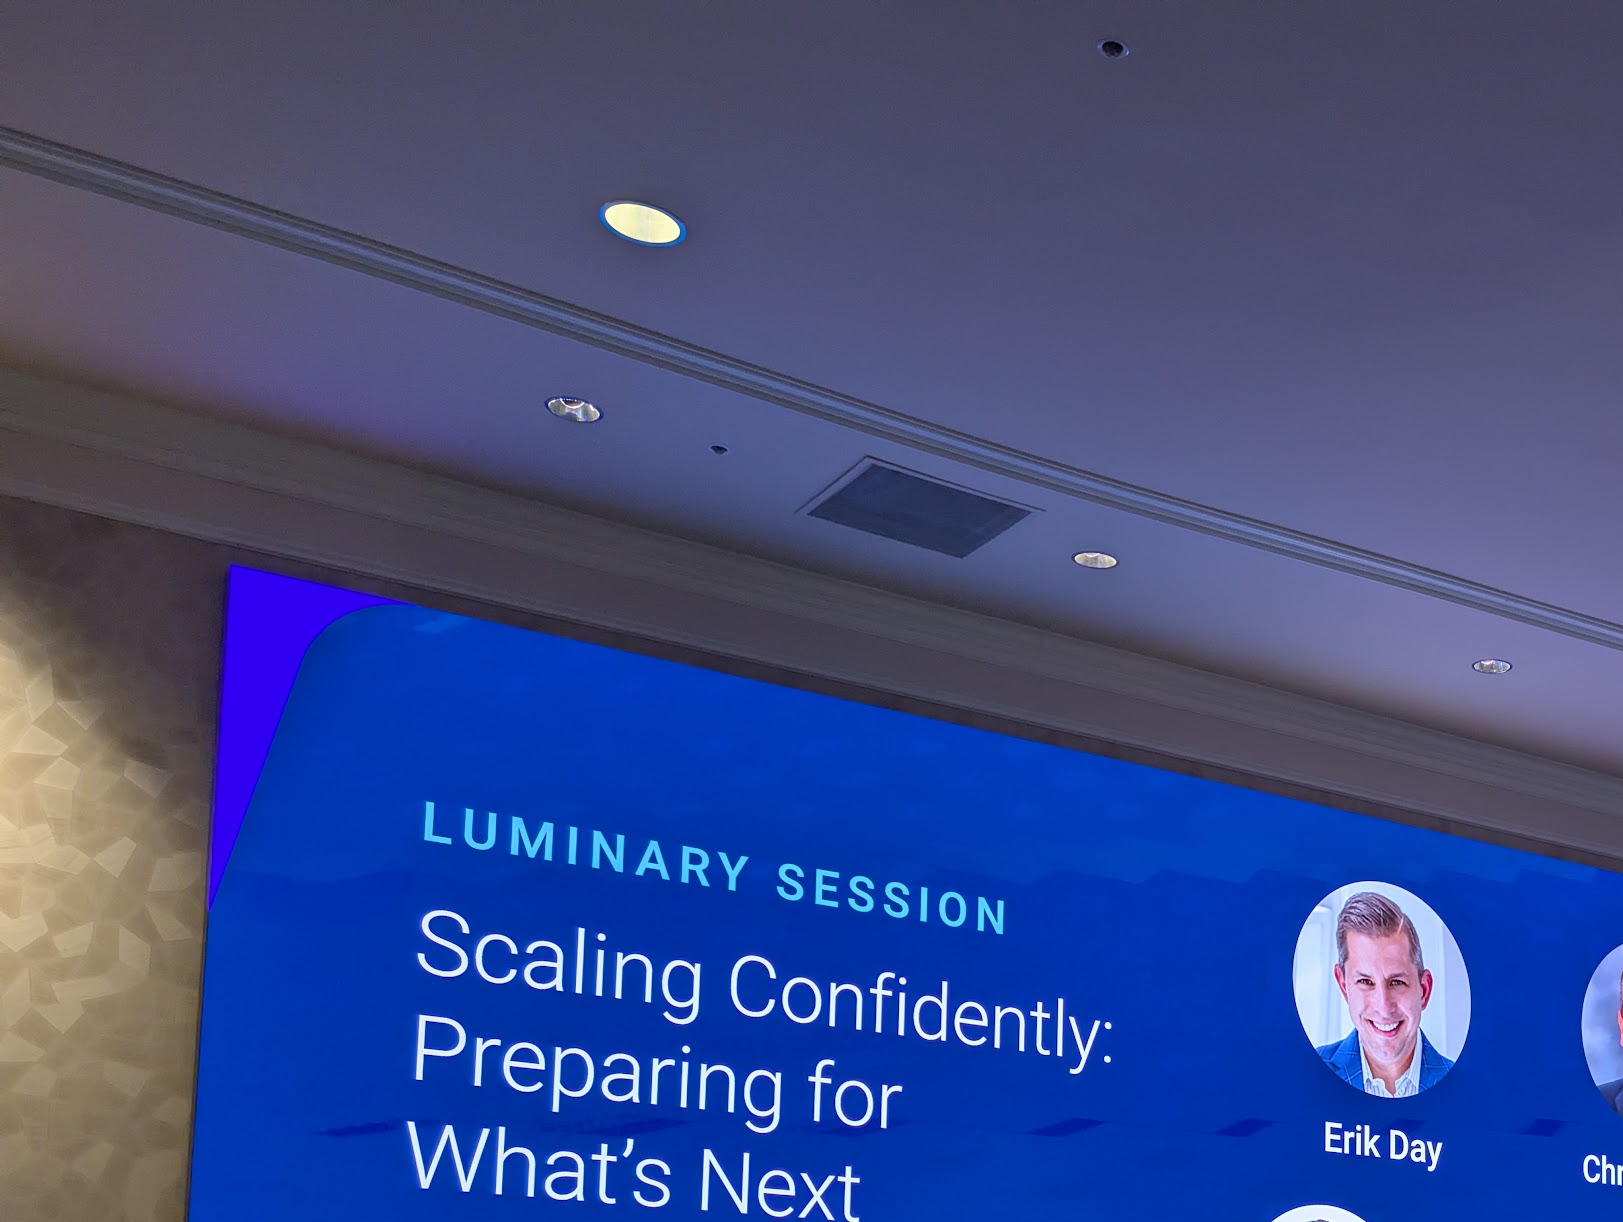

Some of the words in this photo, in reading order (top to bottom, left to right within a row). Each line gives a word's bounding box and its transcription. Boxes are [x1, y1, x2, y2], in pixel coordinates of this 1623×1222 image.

[423, 801, 750, 892] LUMINARY
[775, 863, 1006, 935] SESSION
[416, 909, 702, 1026] Scaling
[729, 954, 1113, 1076] Confidently:
[414, 1014, 783, 1134] Preparing
[807, 1058, 903, 1130] for
[406, 1120, 672, 1209] What’s
[1323, 1121, 1381, 1158] Erik
[1389, 1129, 1444, 1172] Day
